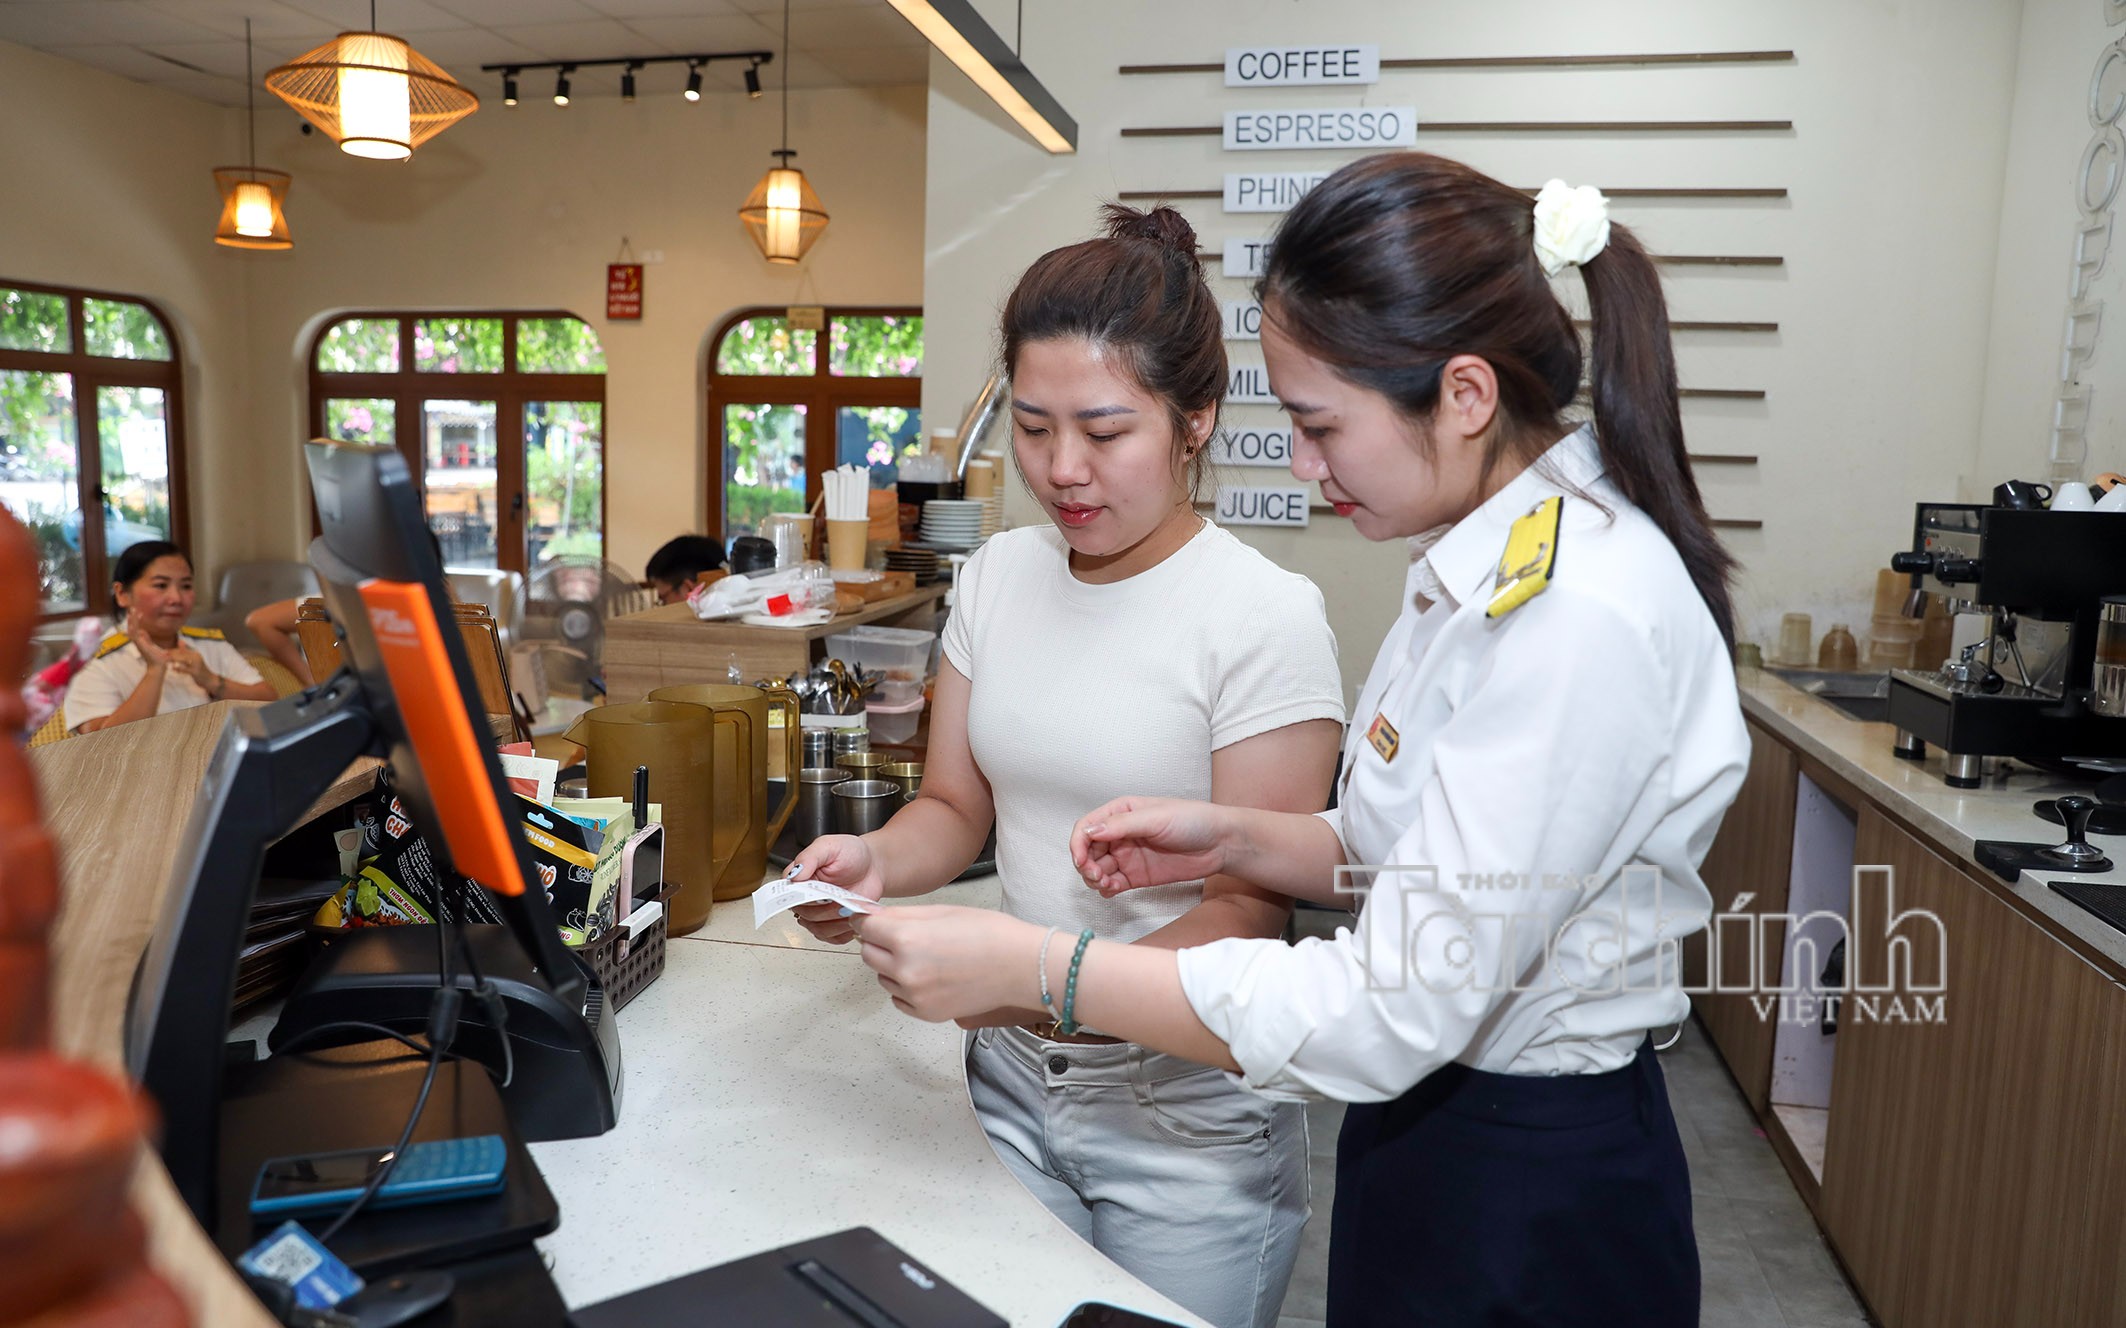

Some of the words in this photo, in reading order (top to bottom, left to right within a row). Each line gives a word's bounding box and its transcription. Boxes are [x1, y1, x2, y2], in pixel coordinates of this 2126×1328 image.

[1237, 49, 1361, 80] COFFEE
[1235, 112, 1400, 143] ESPRESSO
[1221, 432, 1293, 460] YOG
[1221, 492, 1303, 521] JUICE
